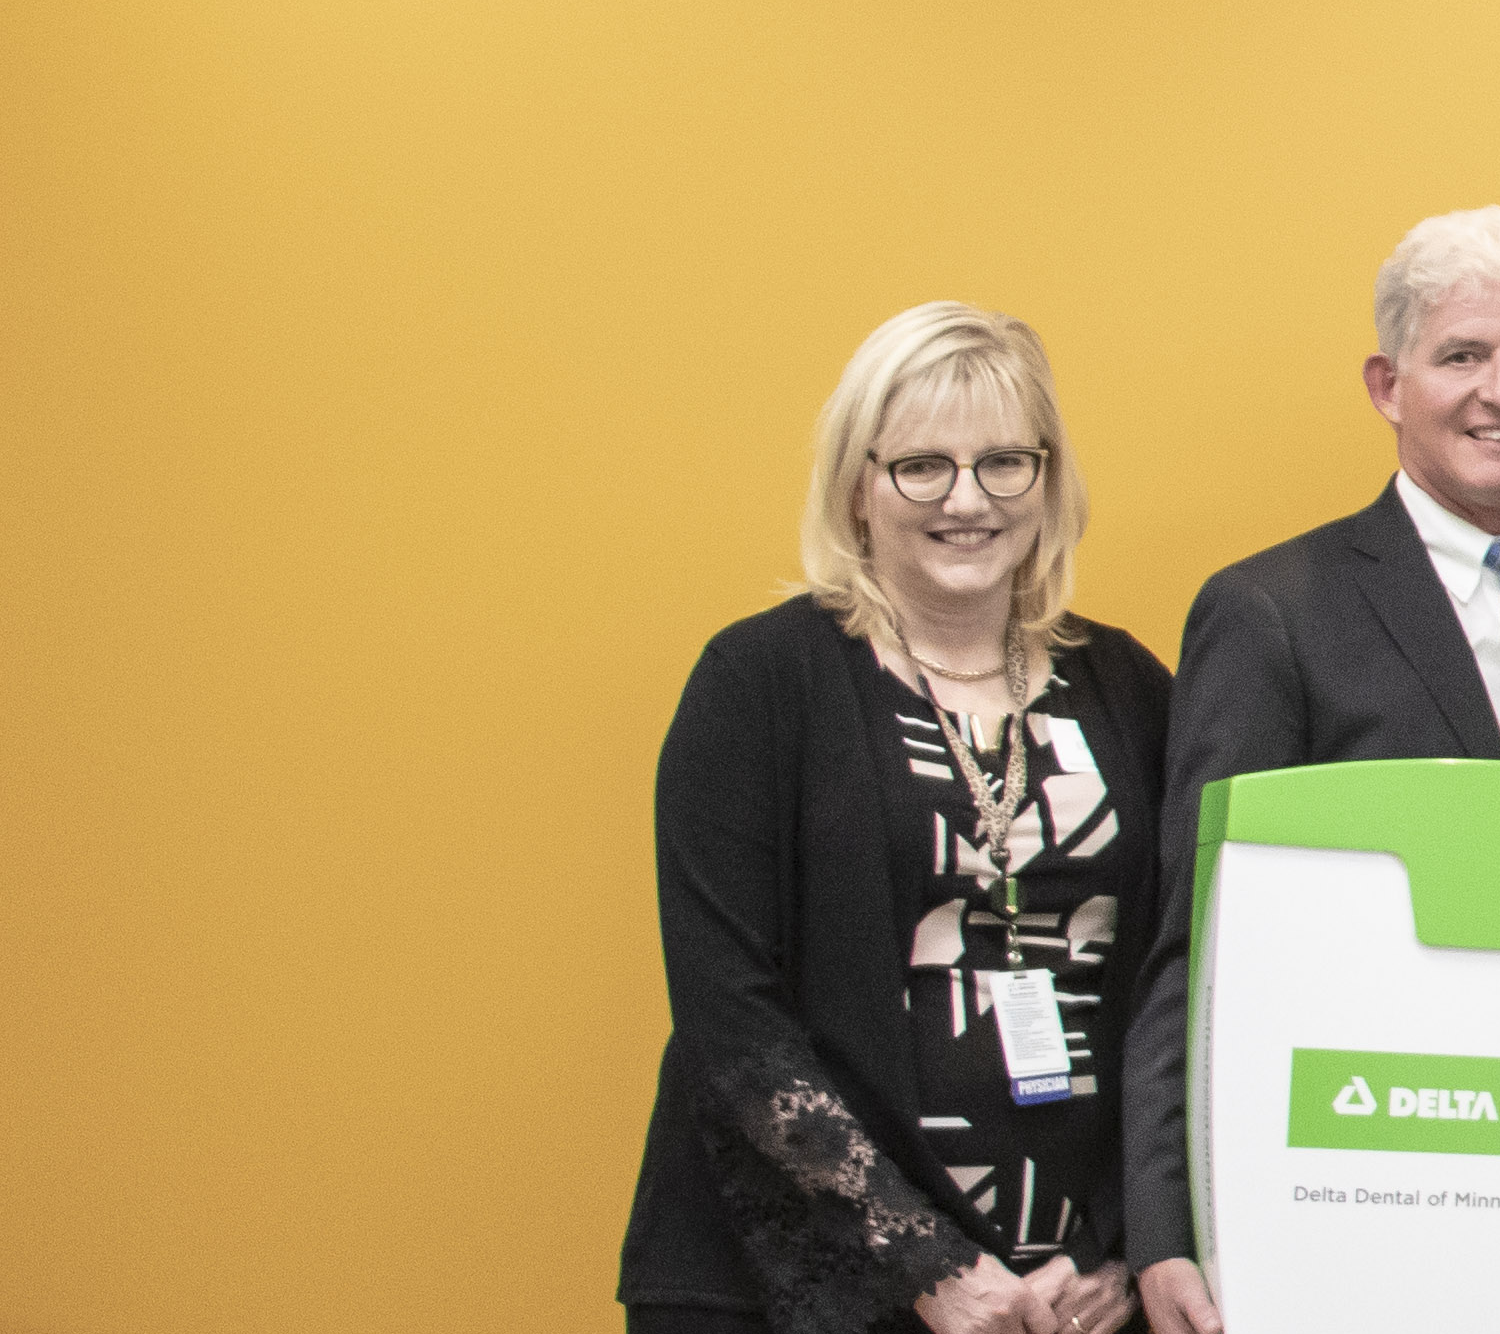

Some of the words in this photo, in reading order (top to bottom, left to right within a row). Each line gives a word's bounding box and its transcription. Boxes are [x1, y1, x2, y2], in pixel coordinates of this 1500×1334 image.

[1388, 1086, 1499, 1122] DELTA
[1293, 1185, 1347, 1204] Delta
[1355, 1187, 1420, 1206] Dental
[1427, 1190, 1448, 1208] of
